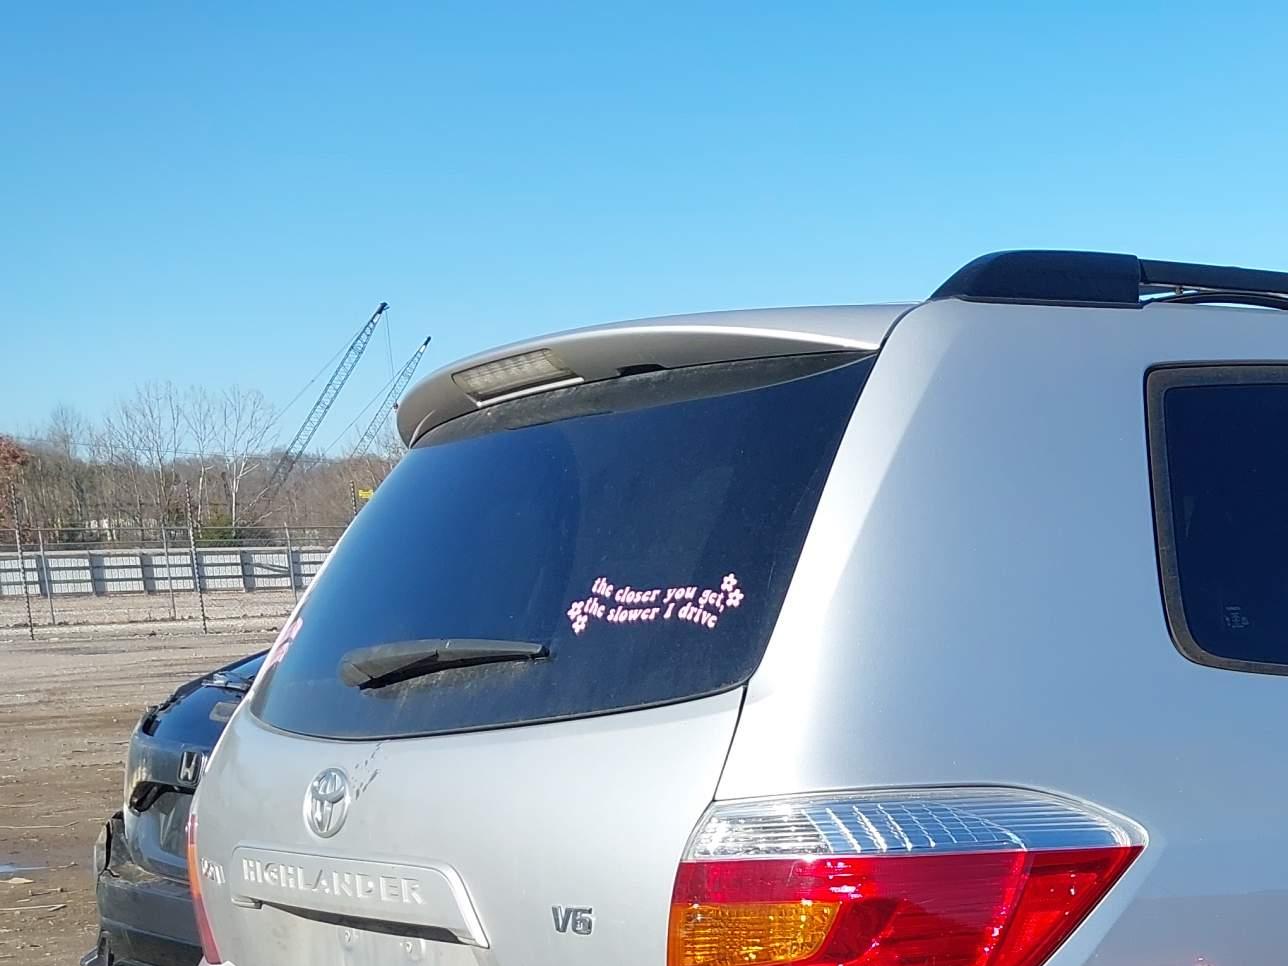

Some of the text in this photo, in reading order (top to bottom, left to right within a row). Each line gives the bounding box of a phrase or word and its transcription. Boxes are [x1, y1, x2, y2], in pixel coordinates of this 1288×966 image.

[592, 577, 613, 597] the
[615, 586, 660, 603] closer
[663, 586, 697, 603] you
[584, 597, 605, 618] the
[607, 606, 660, 622] slower
[678, 602, 718, 628] drive
[242, 858, 427, 905] HIGHLANDER
[551, 905, 594, 936] V6
